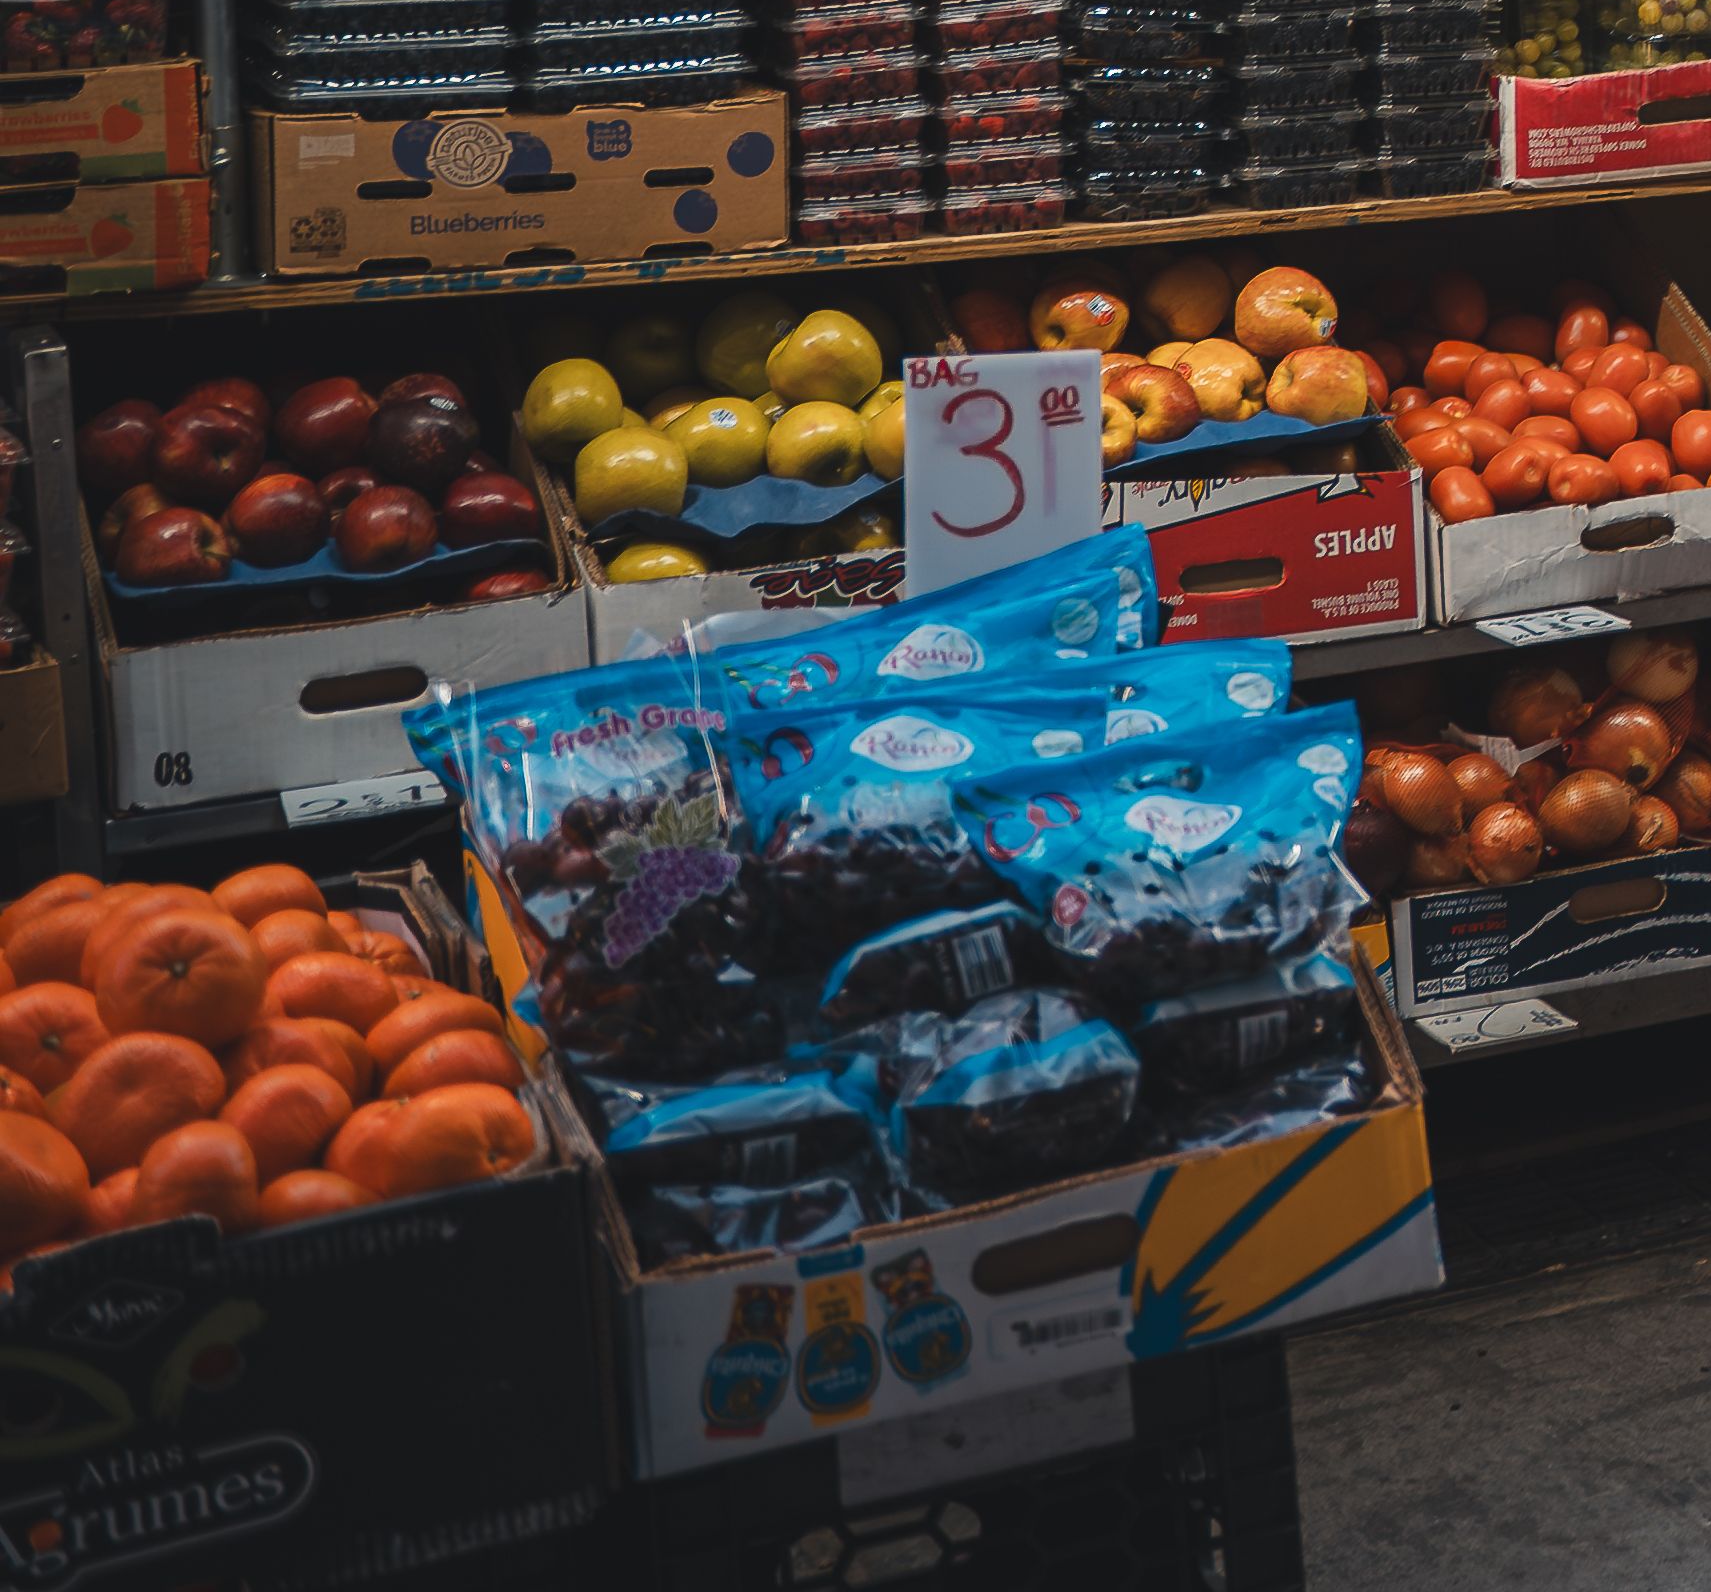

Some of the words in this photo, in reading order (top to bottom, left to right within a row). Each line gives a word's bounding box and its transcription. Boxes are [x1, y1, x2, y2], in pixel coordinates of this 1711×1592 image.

[440, 123, 494, 156] naturipe
[409, 209, 546, 237] Blueberries
[908, 357, 979, 386] BAG
[931, 388, 1025, 538] 3
[1039, 385, 1081, 424] 00
[1314, 523, 1396, 558] APPLES
[154, 751, 194, 788] 08
[78, 1445, 185, 1492] Atlas
